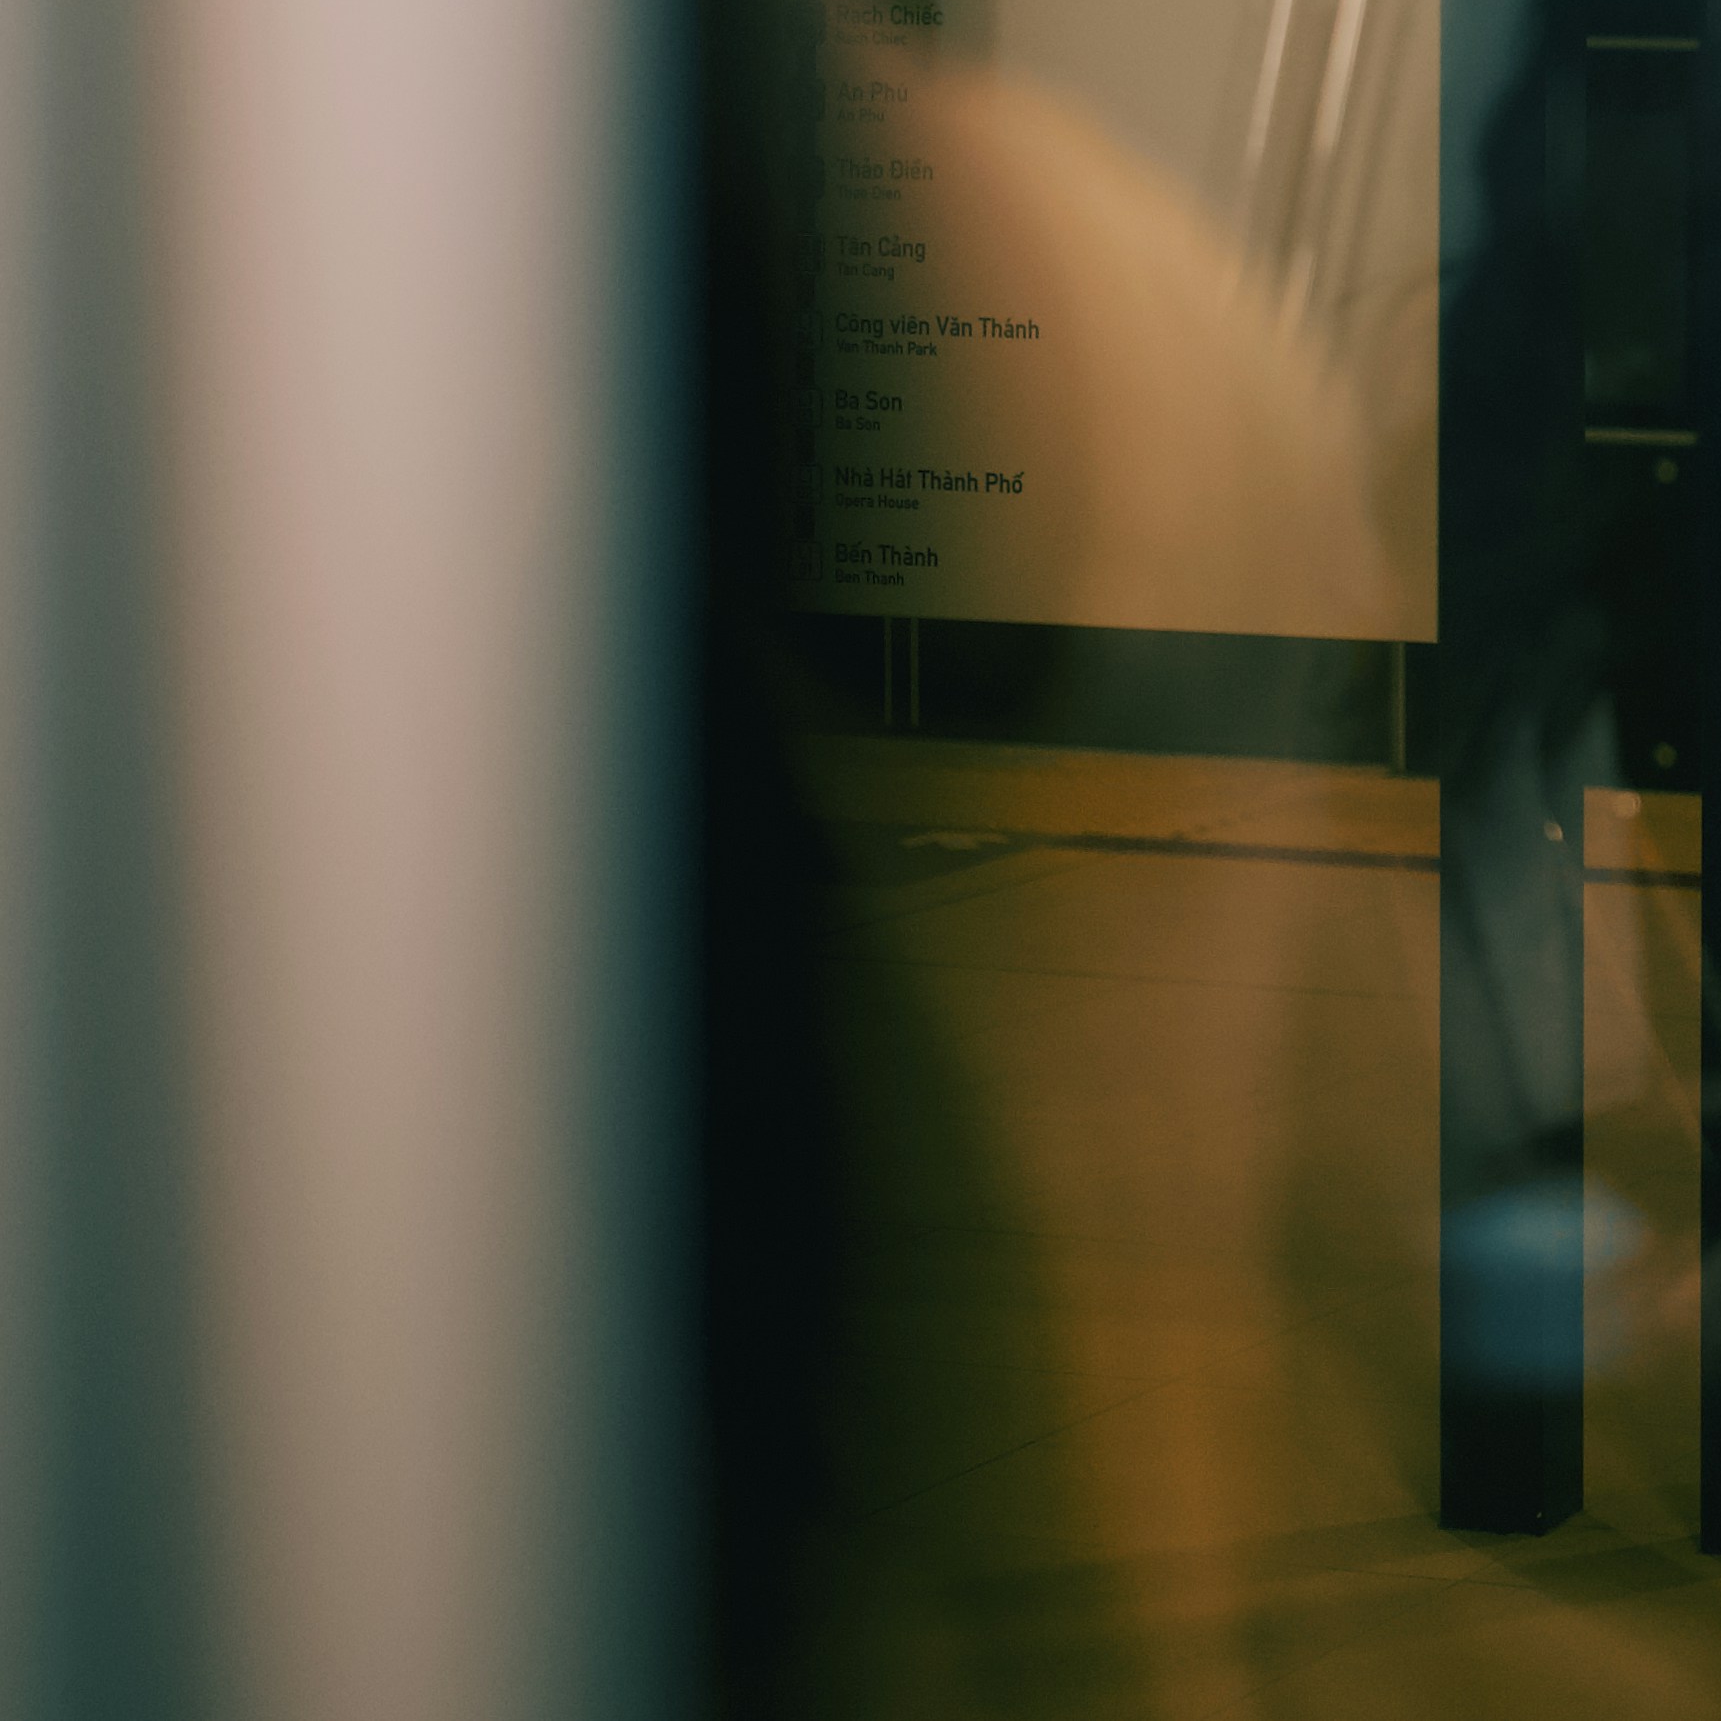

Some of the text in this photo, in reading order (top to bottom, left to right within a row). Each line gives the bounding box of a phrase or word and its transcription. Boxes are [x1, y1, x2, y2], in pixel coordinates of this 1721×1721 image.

[835, 312, 1041, 340] Công viên Văn Thánh
[834, 389, 860, 411] Ba
[864, 390, 904, 412] Son
[917, 469, 979, 493] Thành
[984, 471, 1025, 495] Phố
[877, 544, 939, 568] Thành
